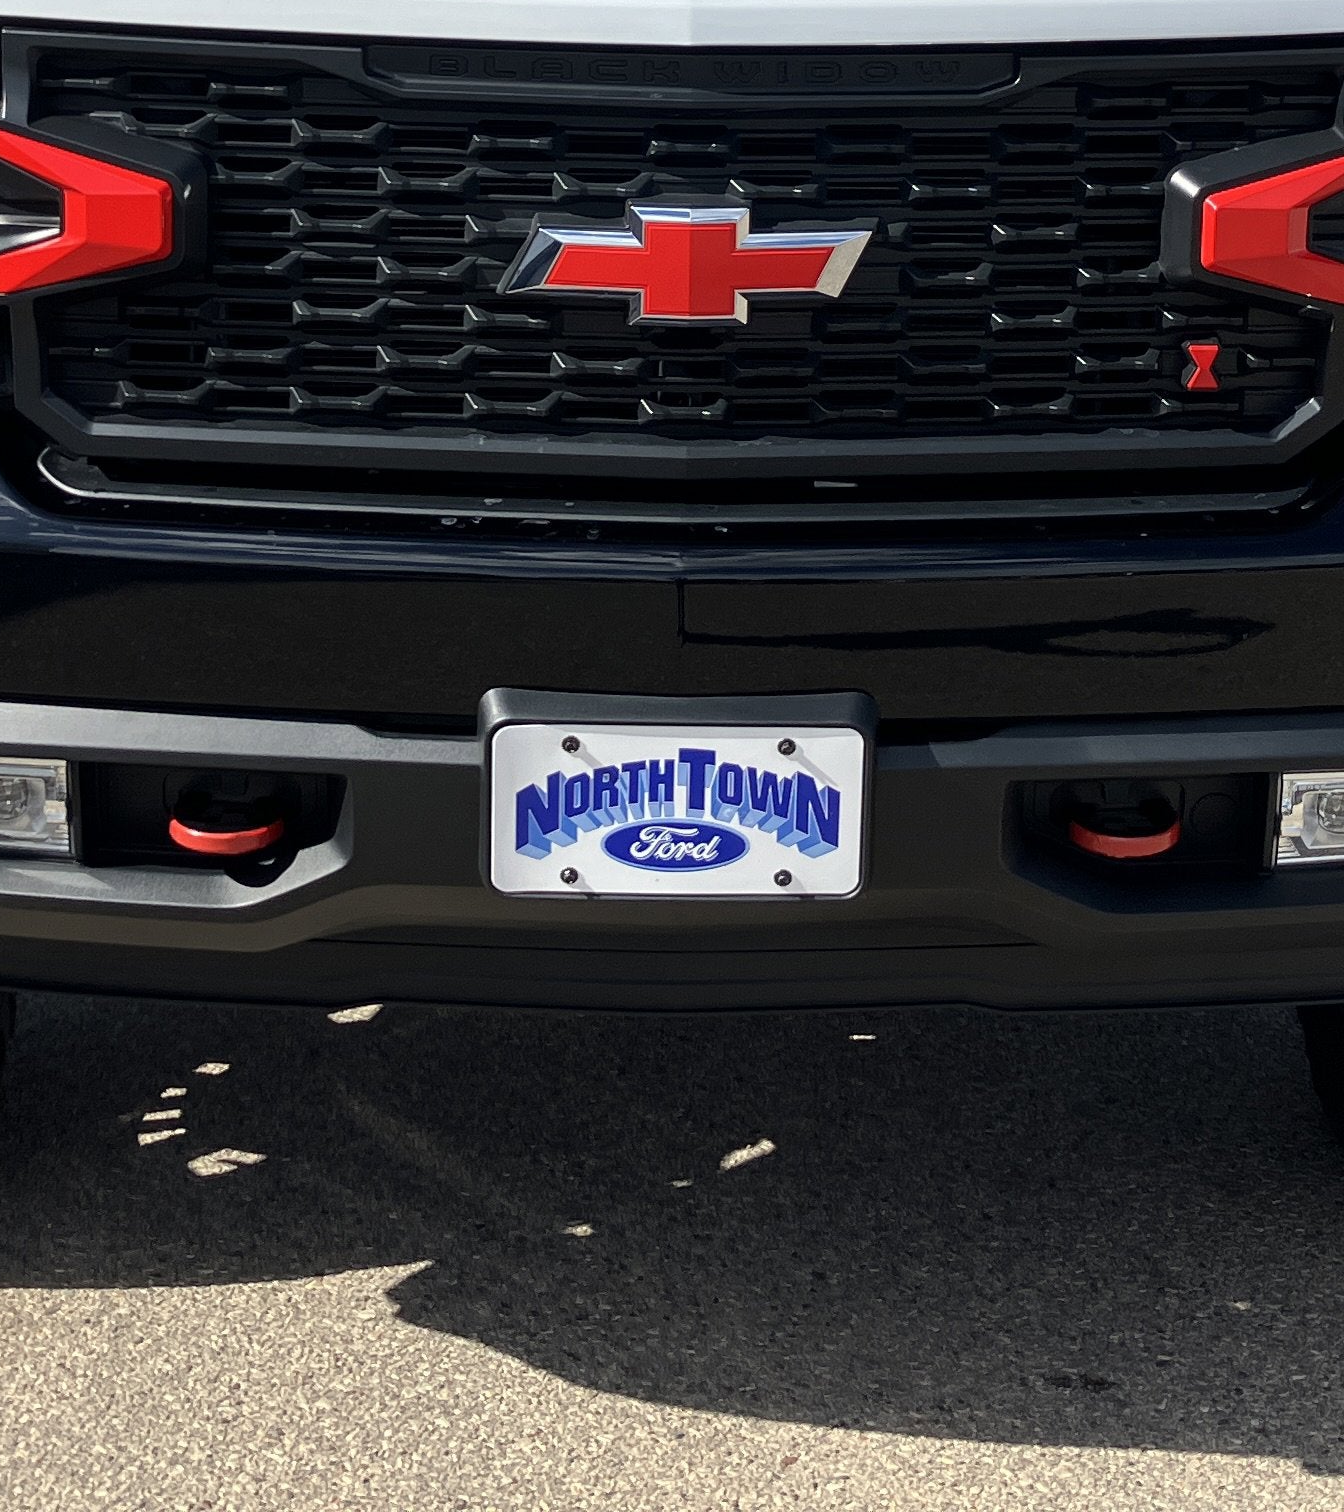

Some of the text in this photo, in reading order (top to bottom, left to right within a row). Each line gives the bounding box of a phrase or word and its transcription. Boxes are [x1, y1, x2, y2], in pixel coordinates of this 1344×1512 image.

[428, 53, 961, 84] BLACK WIDOW
[629, 825, 721, 862] Ford
